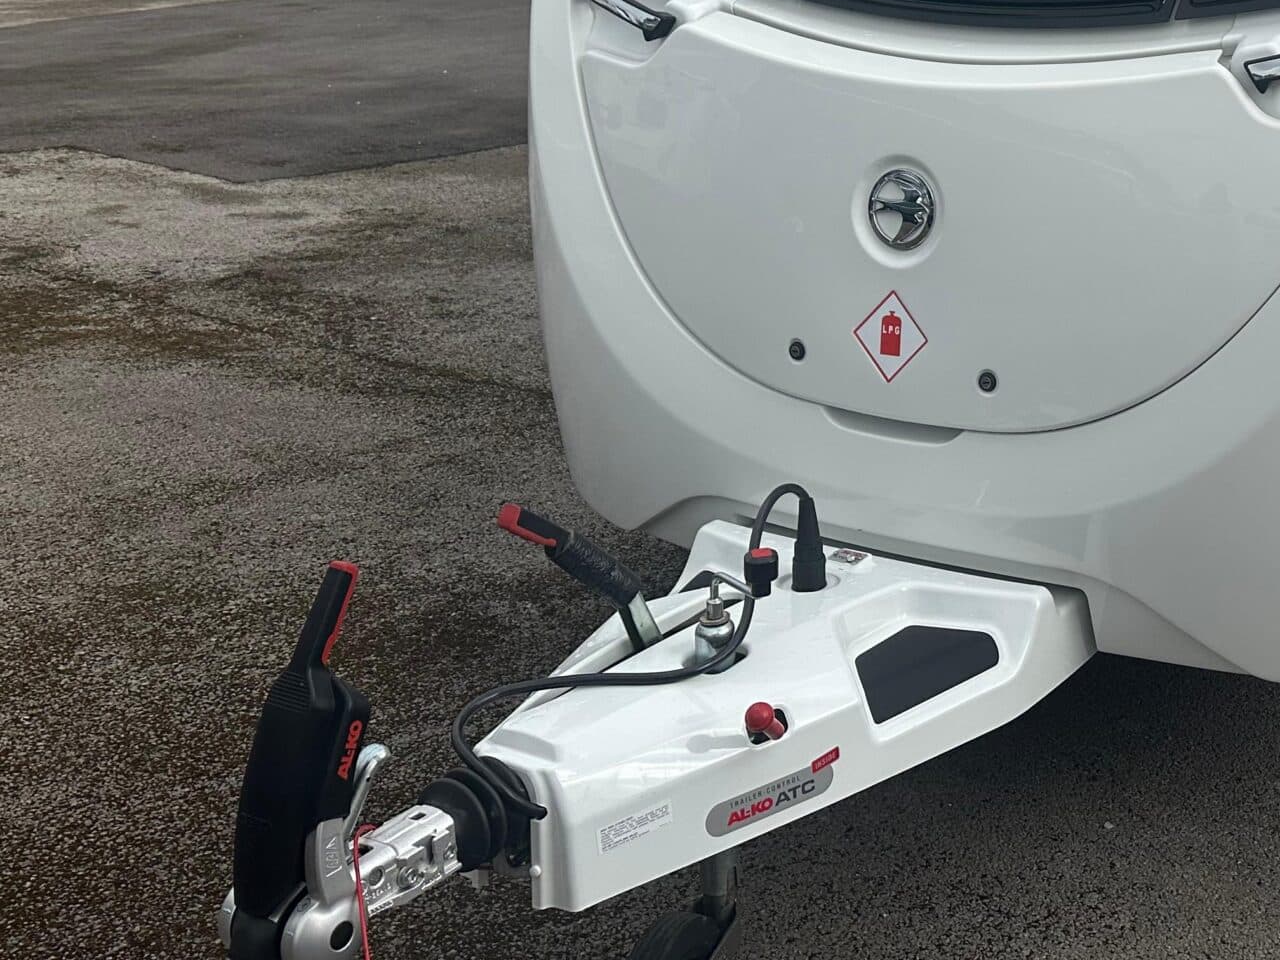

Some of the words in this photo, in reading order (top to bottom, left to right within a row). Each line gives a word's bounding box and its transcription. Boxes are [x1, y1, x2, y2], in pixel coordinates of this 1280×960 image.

[882, 324, 900, 335] LPG
[337, 720, 363, 780] AL-KO
[815, 749, 838, 770] INSIDE
[727, 797, 774, 826] AL-KO
[775, 779, 816, 807] ATC
